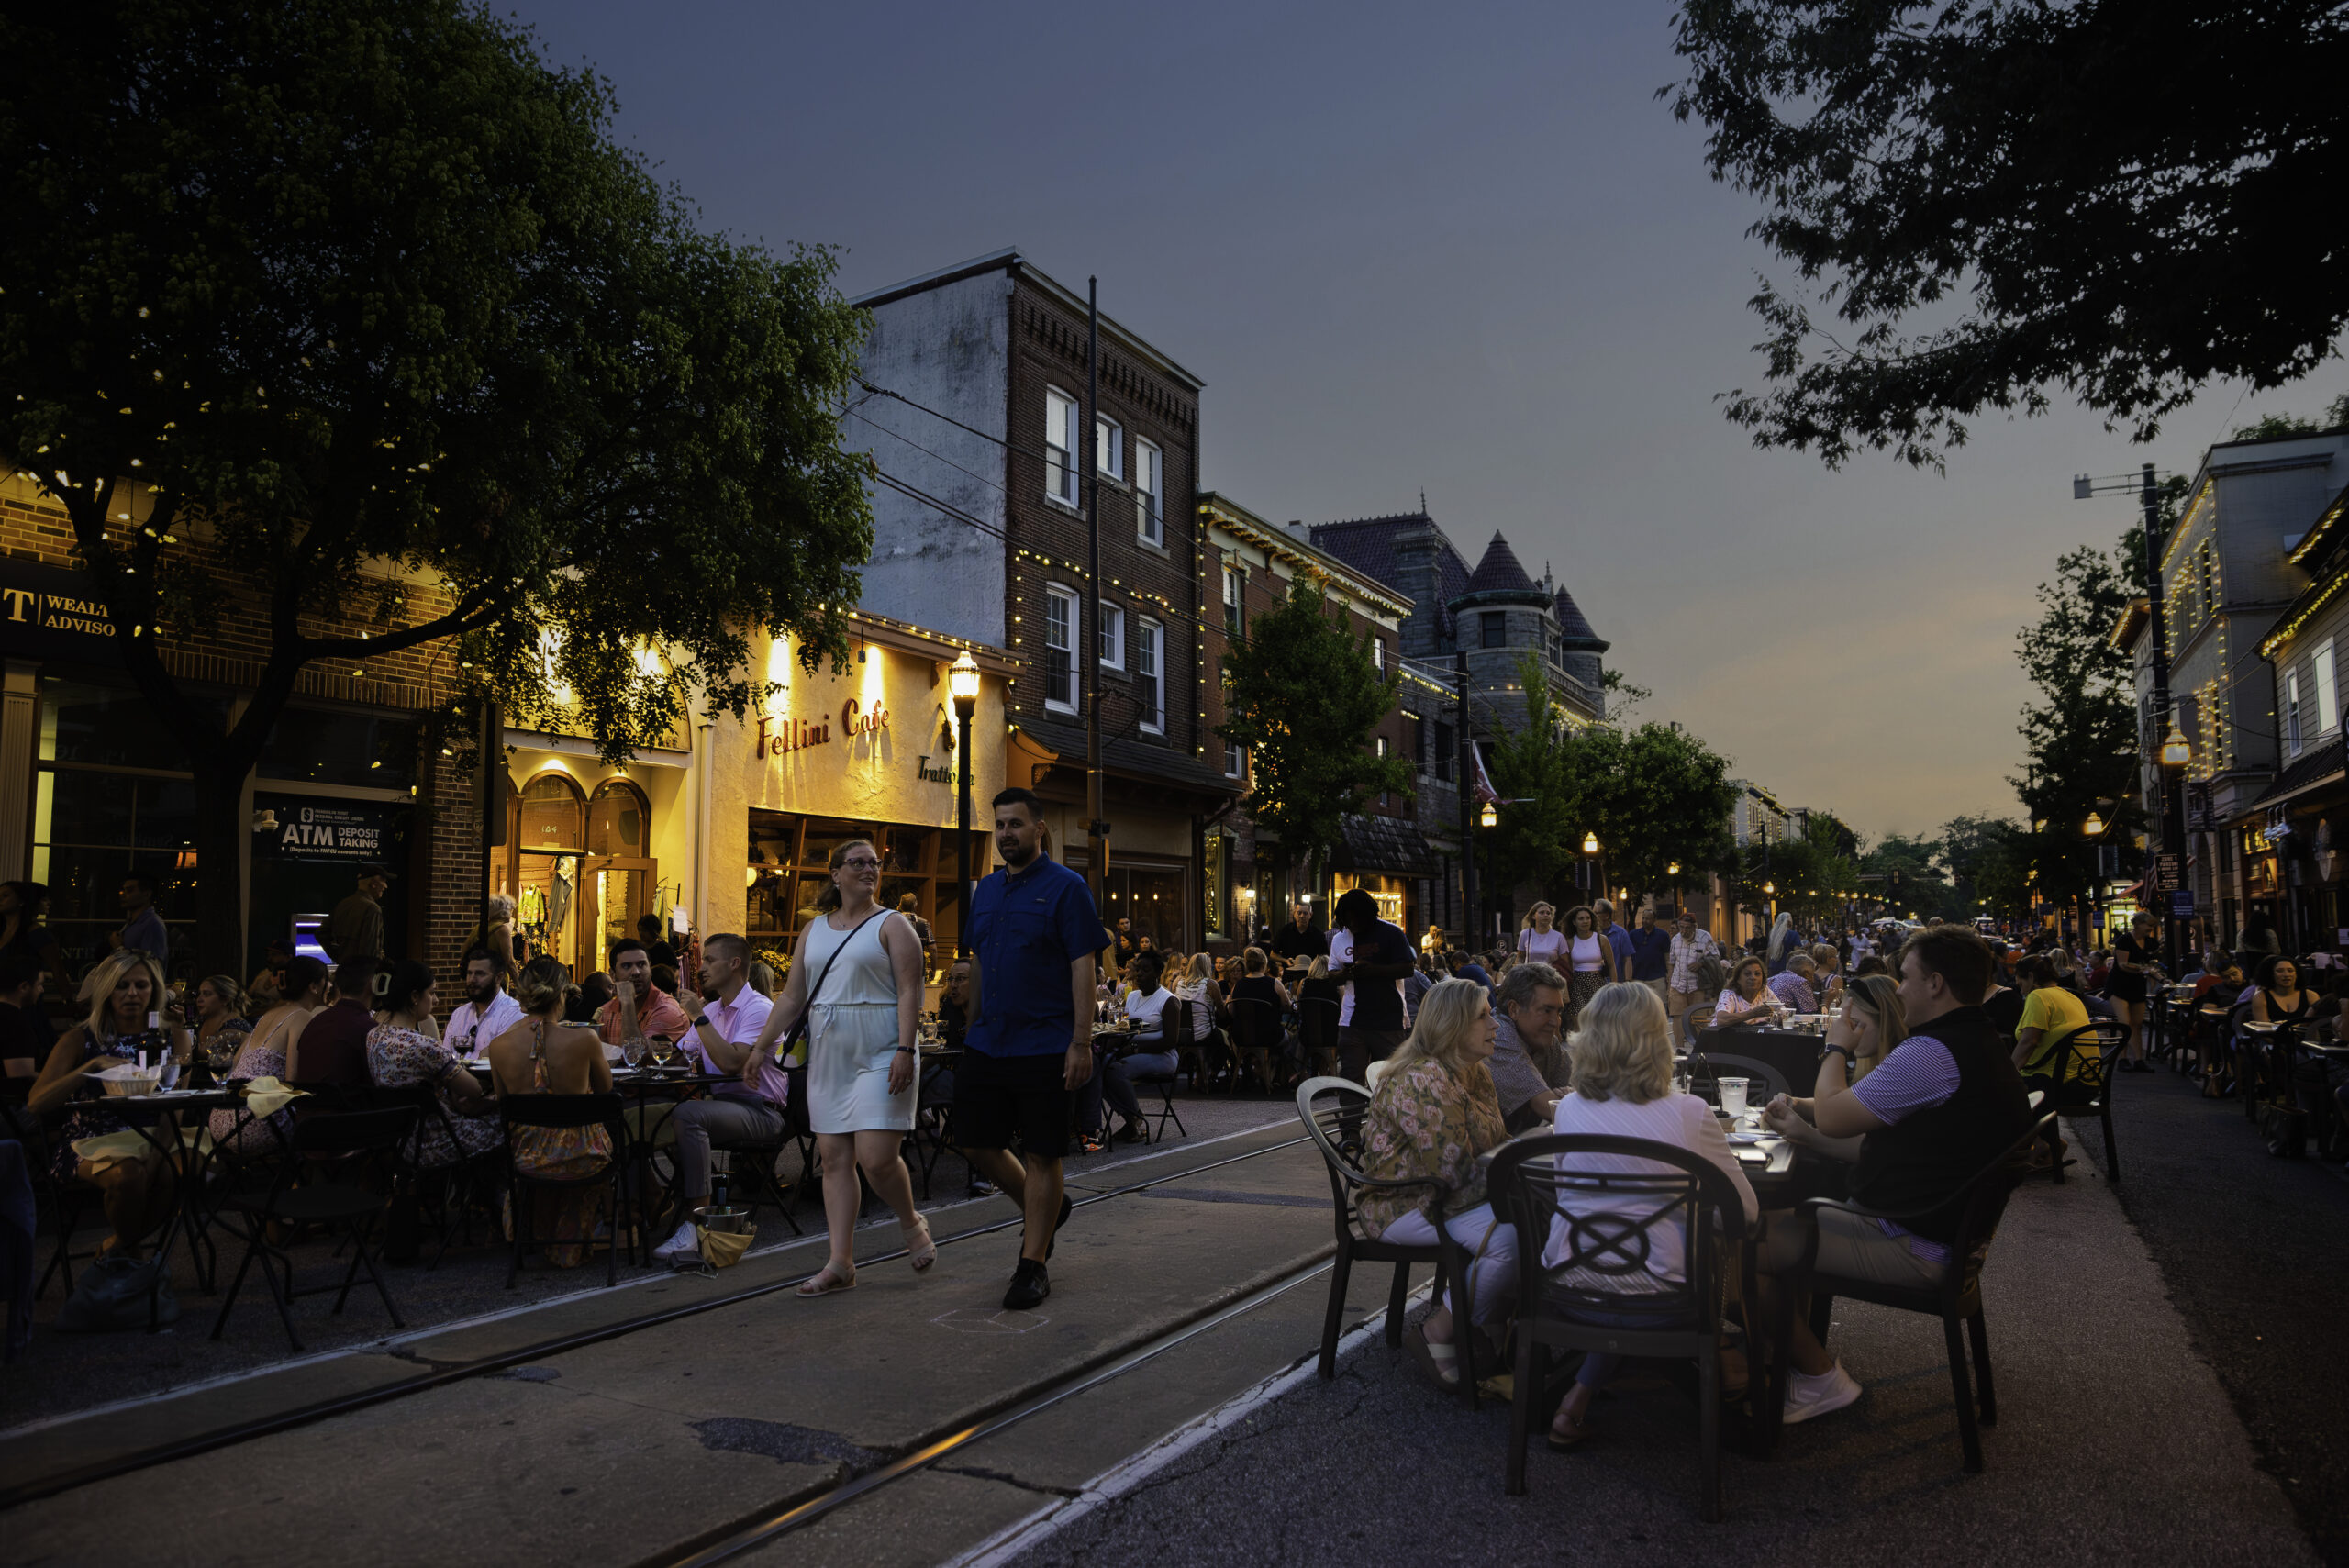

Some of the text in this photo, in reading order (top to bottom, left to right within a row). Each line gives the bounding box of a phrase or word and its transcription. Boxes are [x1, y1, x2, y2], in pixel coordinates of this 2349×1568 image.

[0, 588, 35, 623] T
[46, 595, 110, 617] WEALT
[45, 614, 117, 637] ADVISO
[757, 697, 890, 760] Fellini Cafe
[918, 755, 975, 786] Trattoa
[283, 824, 380, 846] ATM DEPOSIT
[339, 837, 379, 849] TAKING
